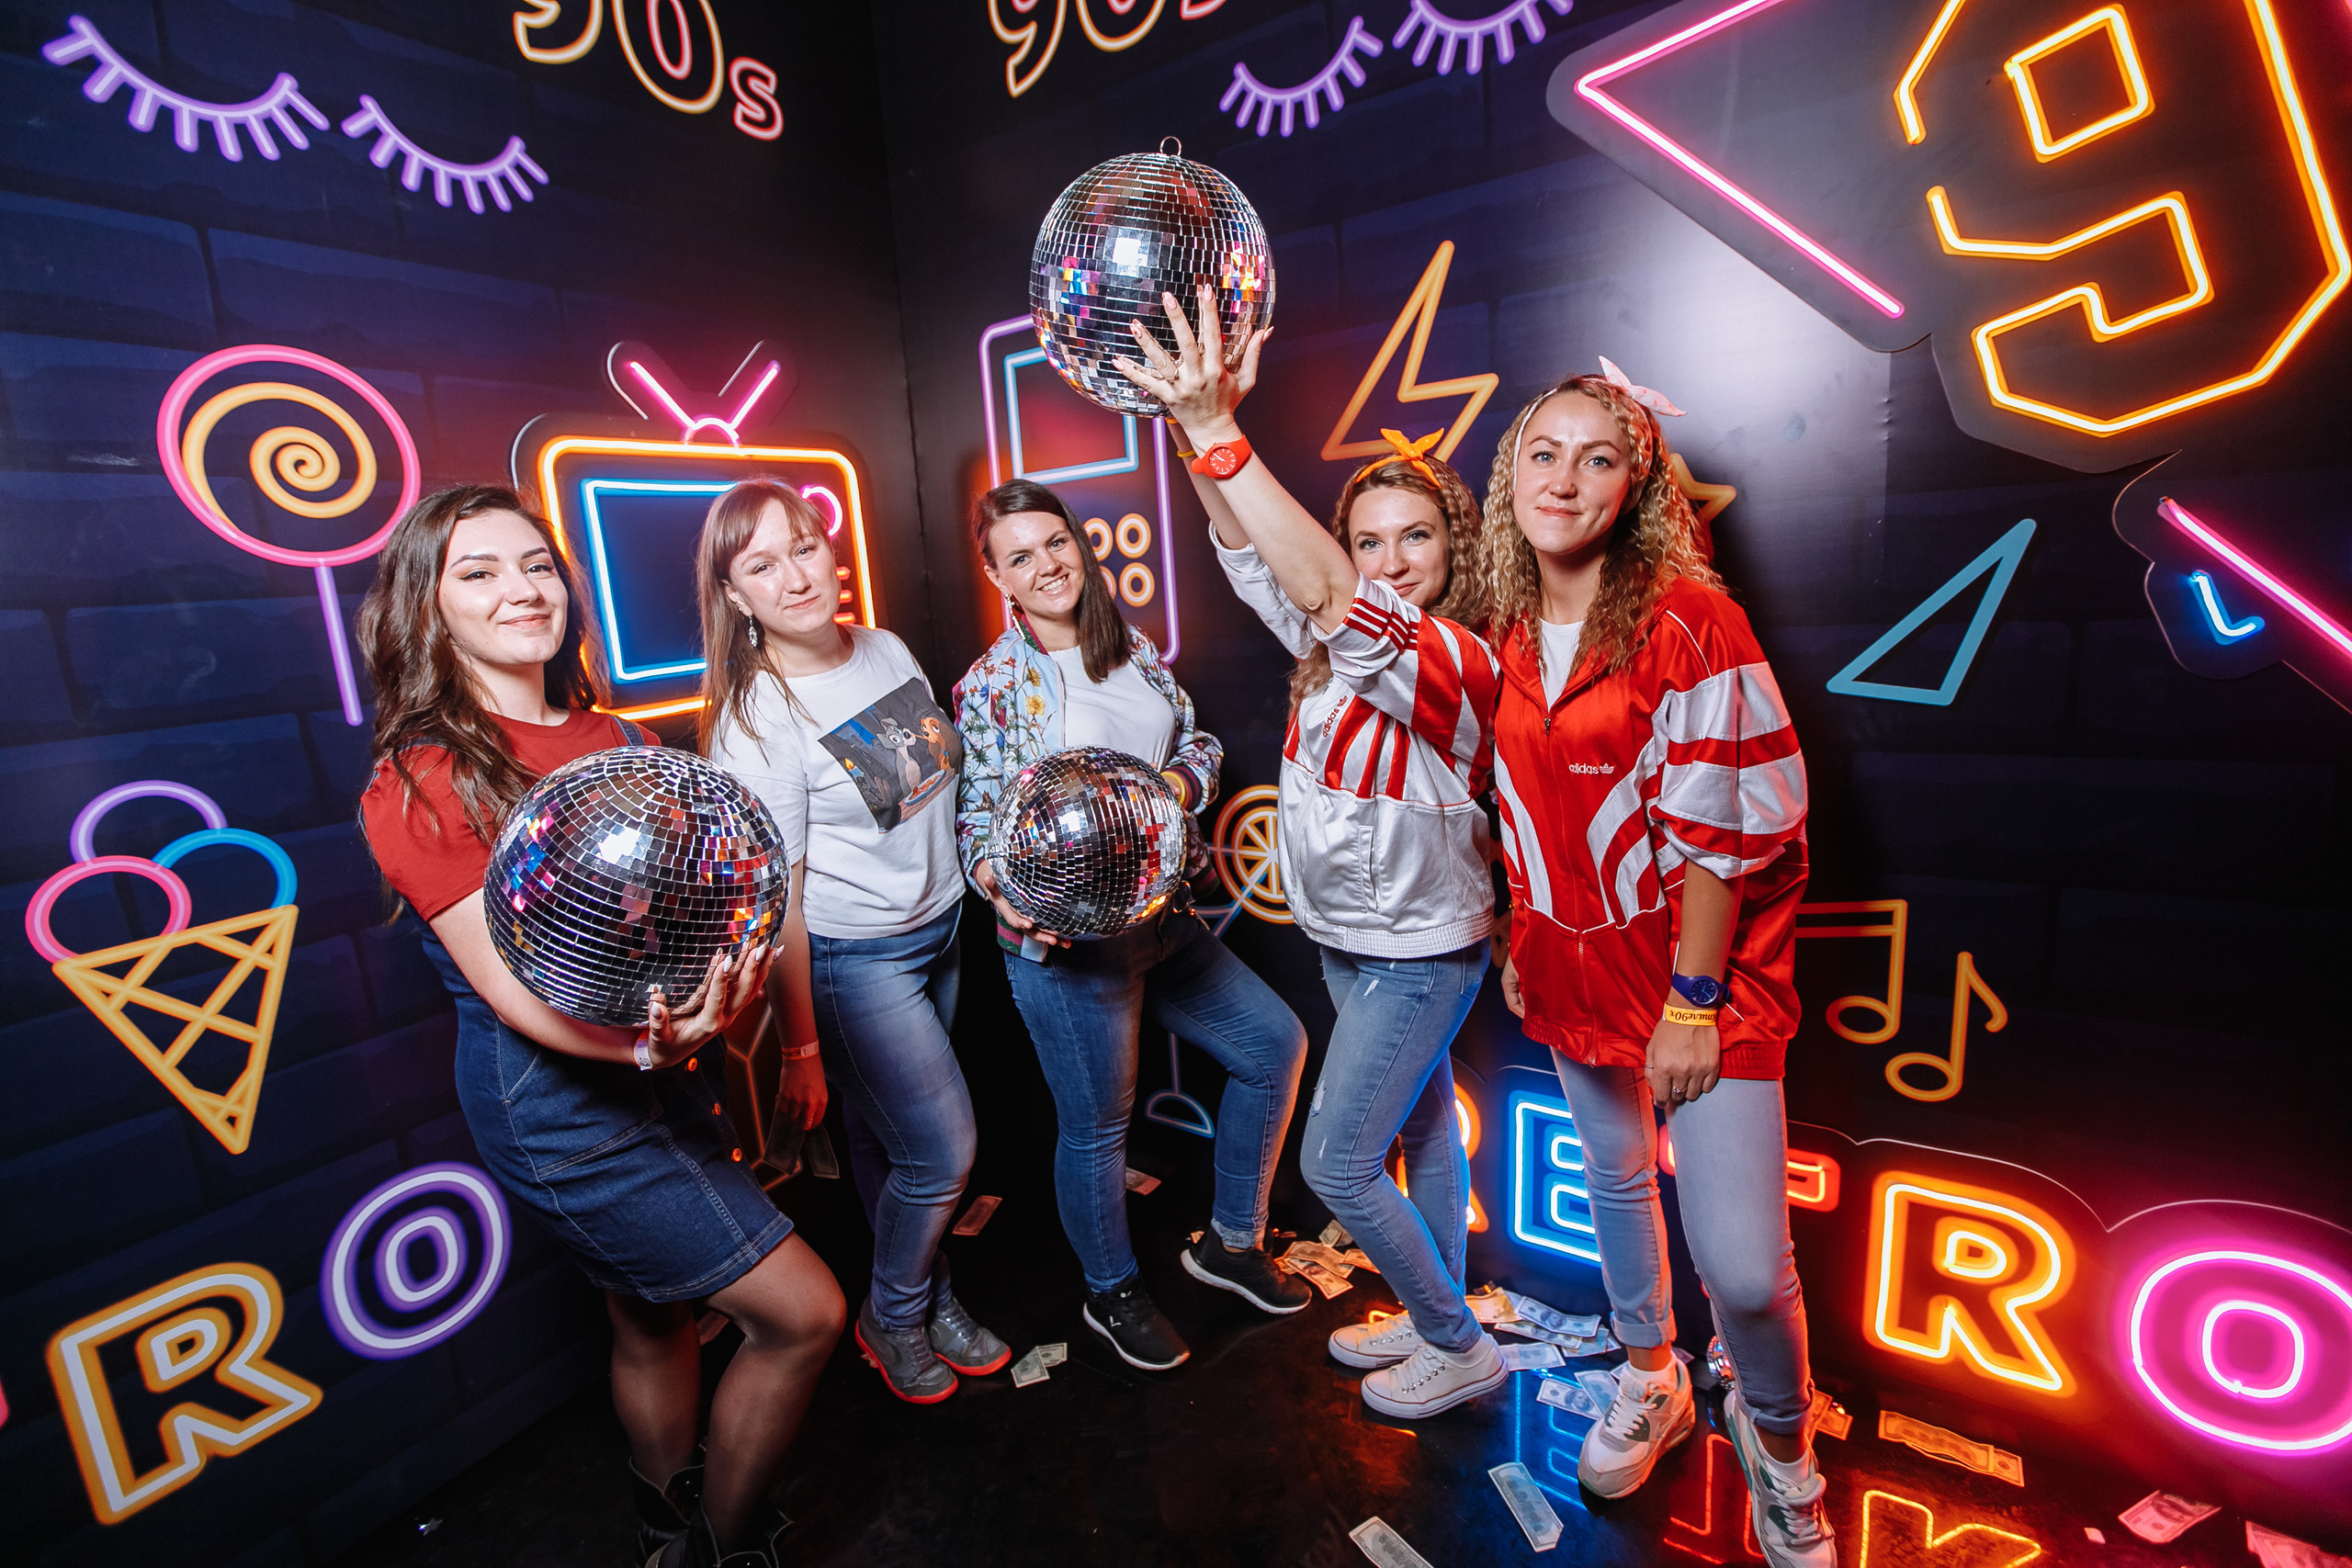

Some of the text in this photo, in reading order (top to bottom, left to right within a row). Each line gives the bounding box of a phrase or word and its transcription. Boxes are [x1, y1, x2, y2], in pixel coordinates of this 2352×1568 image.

[1322, 707, 1340, 738] adidas
[1568, 762, 1599, 774] adidas
[0, 1161, 512, 1525] RO
[1396, 1082, 2352, 1456] ERO
